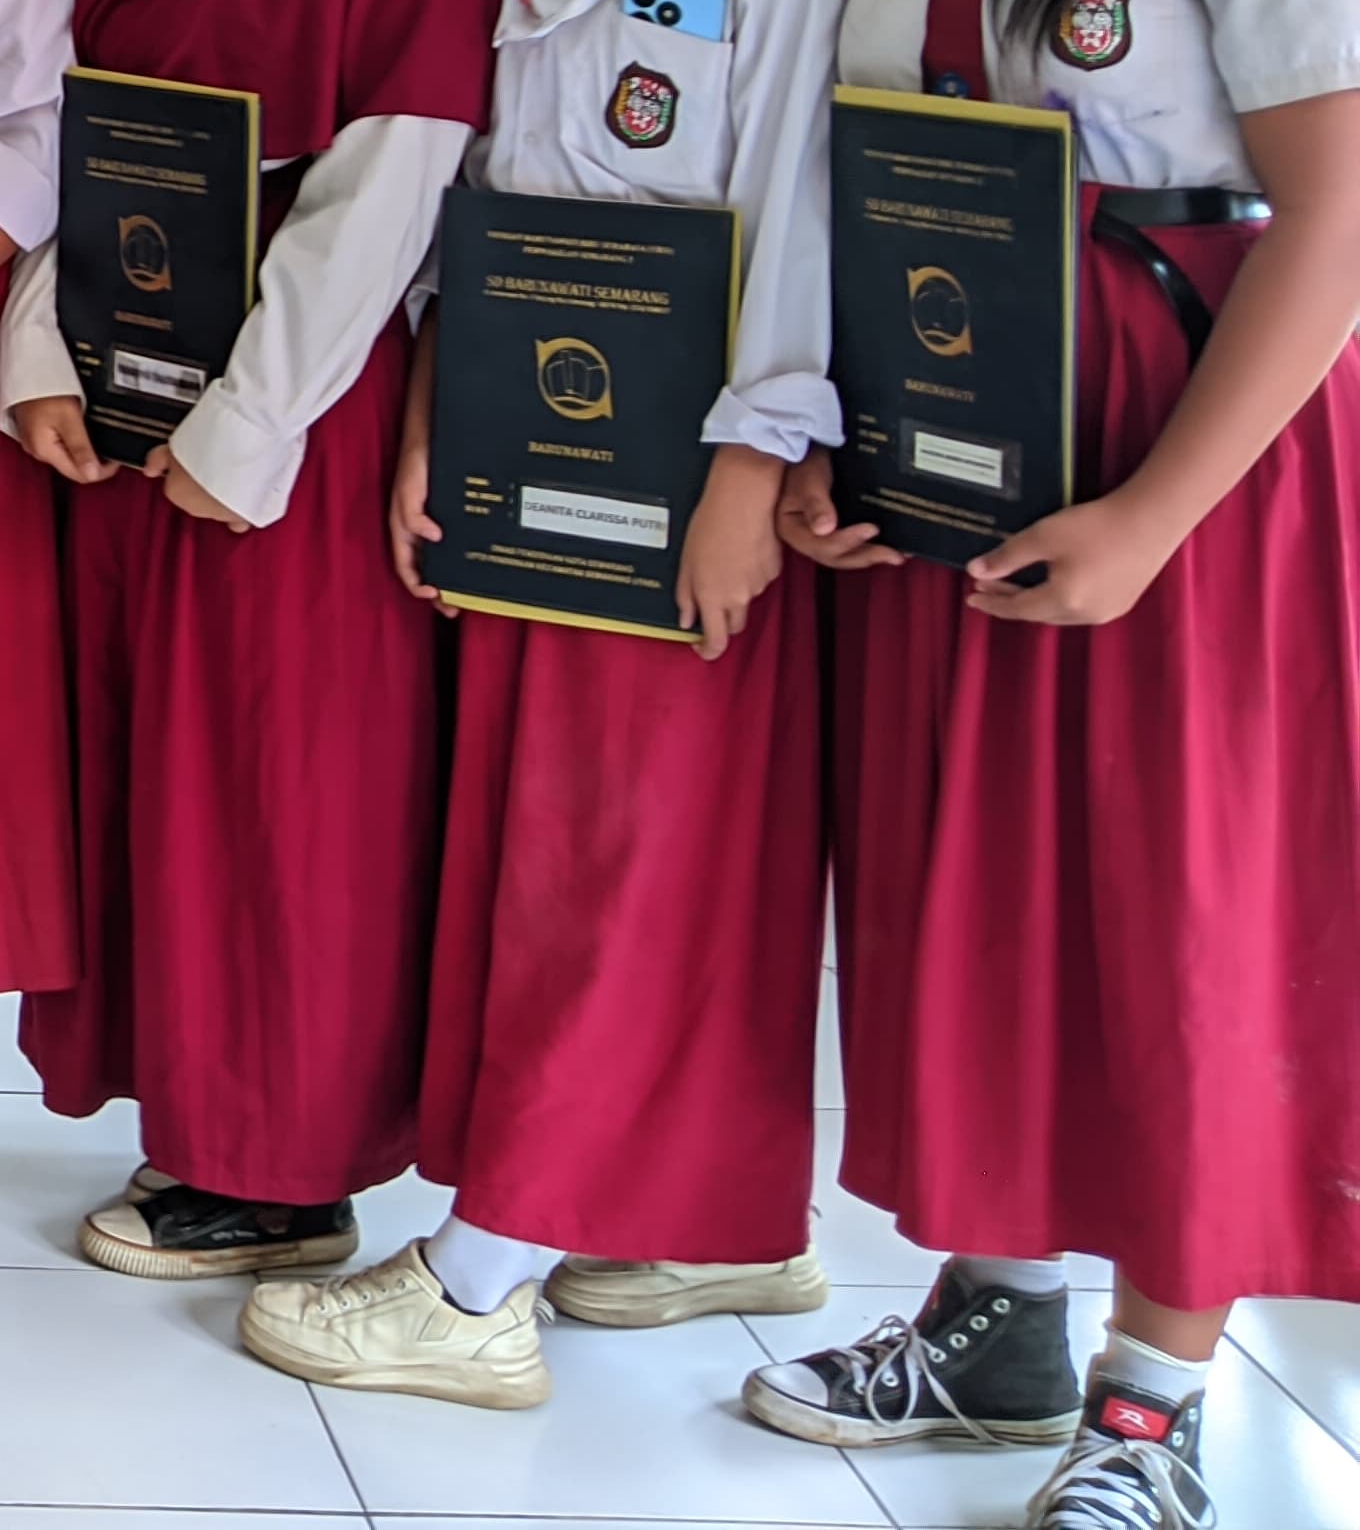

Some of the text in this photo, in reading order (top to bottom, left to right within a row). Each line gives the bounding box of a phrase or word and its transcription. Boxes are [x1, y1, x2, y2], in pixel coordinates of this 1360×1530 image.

[505, 276, 592, 298] BARUNAWATI
[595, 285, 671, 306] SEMARANG
[528, 441, 614, 463] BARUNAWATI
[524, 502, 572, 517] DEANITA
[576, 509, 628, 525] CLARISSA
